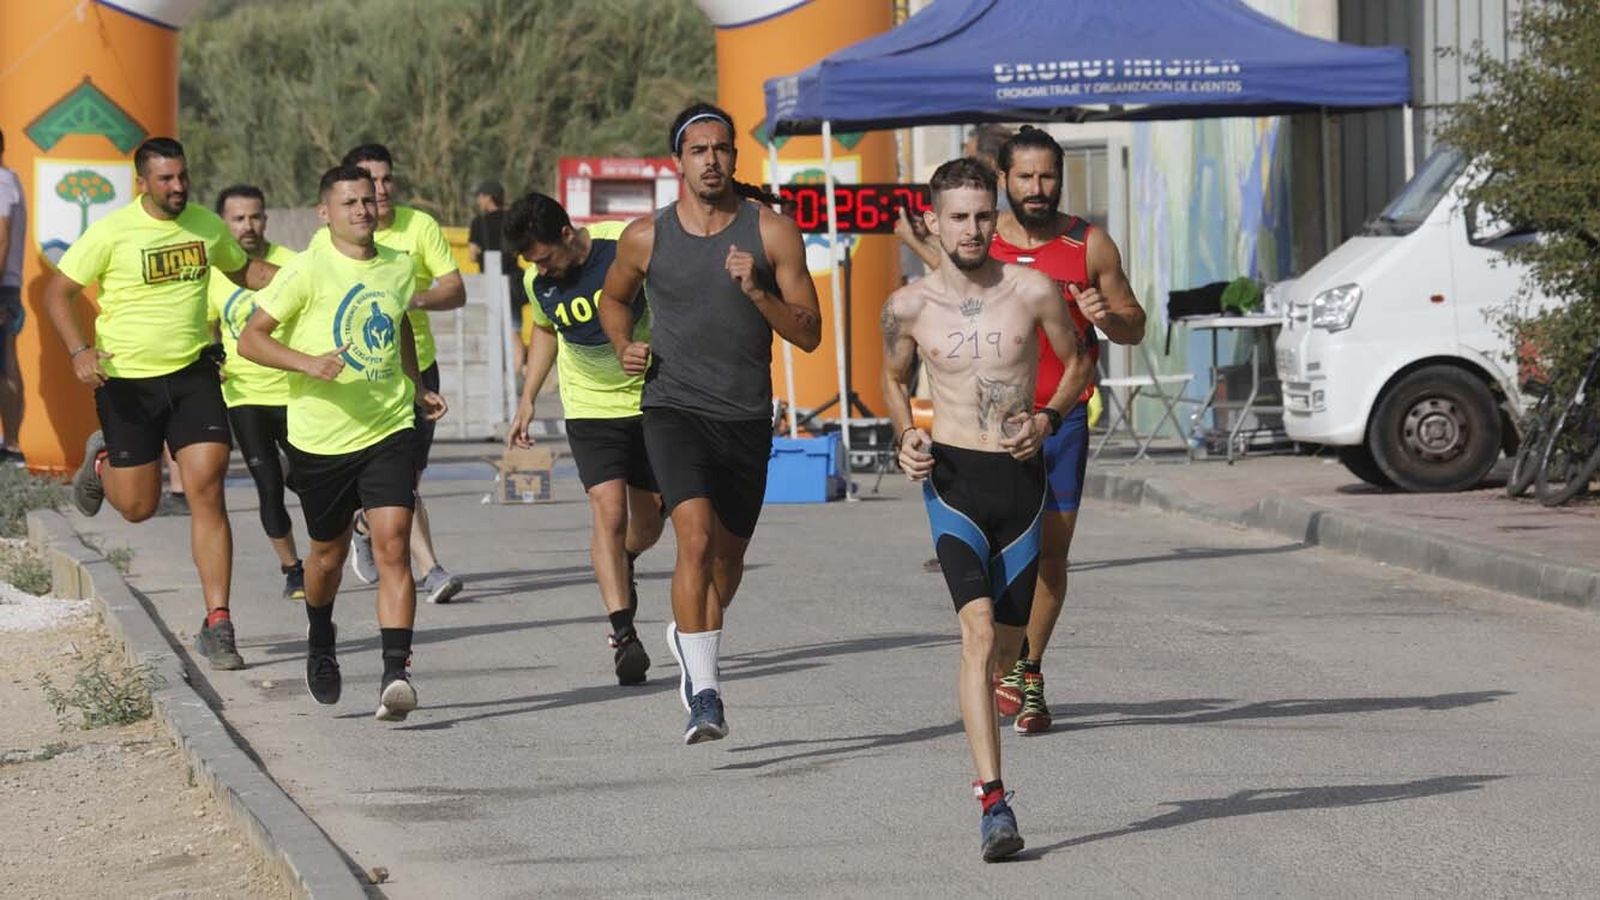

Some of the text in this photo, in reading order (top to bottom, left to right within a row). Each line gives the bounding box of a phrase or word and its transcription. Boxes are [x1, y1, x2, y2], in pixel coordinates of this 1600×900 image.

[996, 83, 1080, 100] CRONOMETRAJE
[1083, 82, 1092, 95] Y
[1174, 80, 1189, 93] DE
[1191, 79, 1242, 93] EVENTOS
[149, 246, 200, 278] LION
[555, 289, 603, 327] 10
[946, 330, 1002, 359] 219
